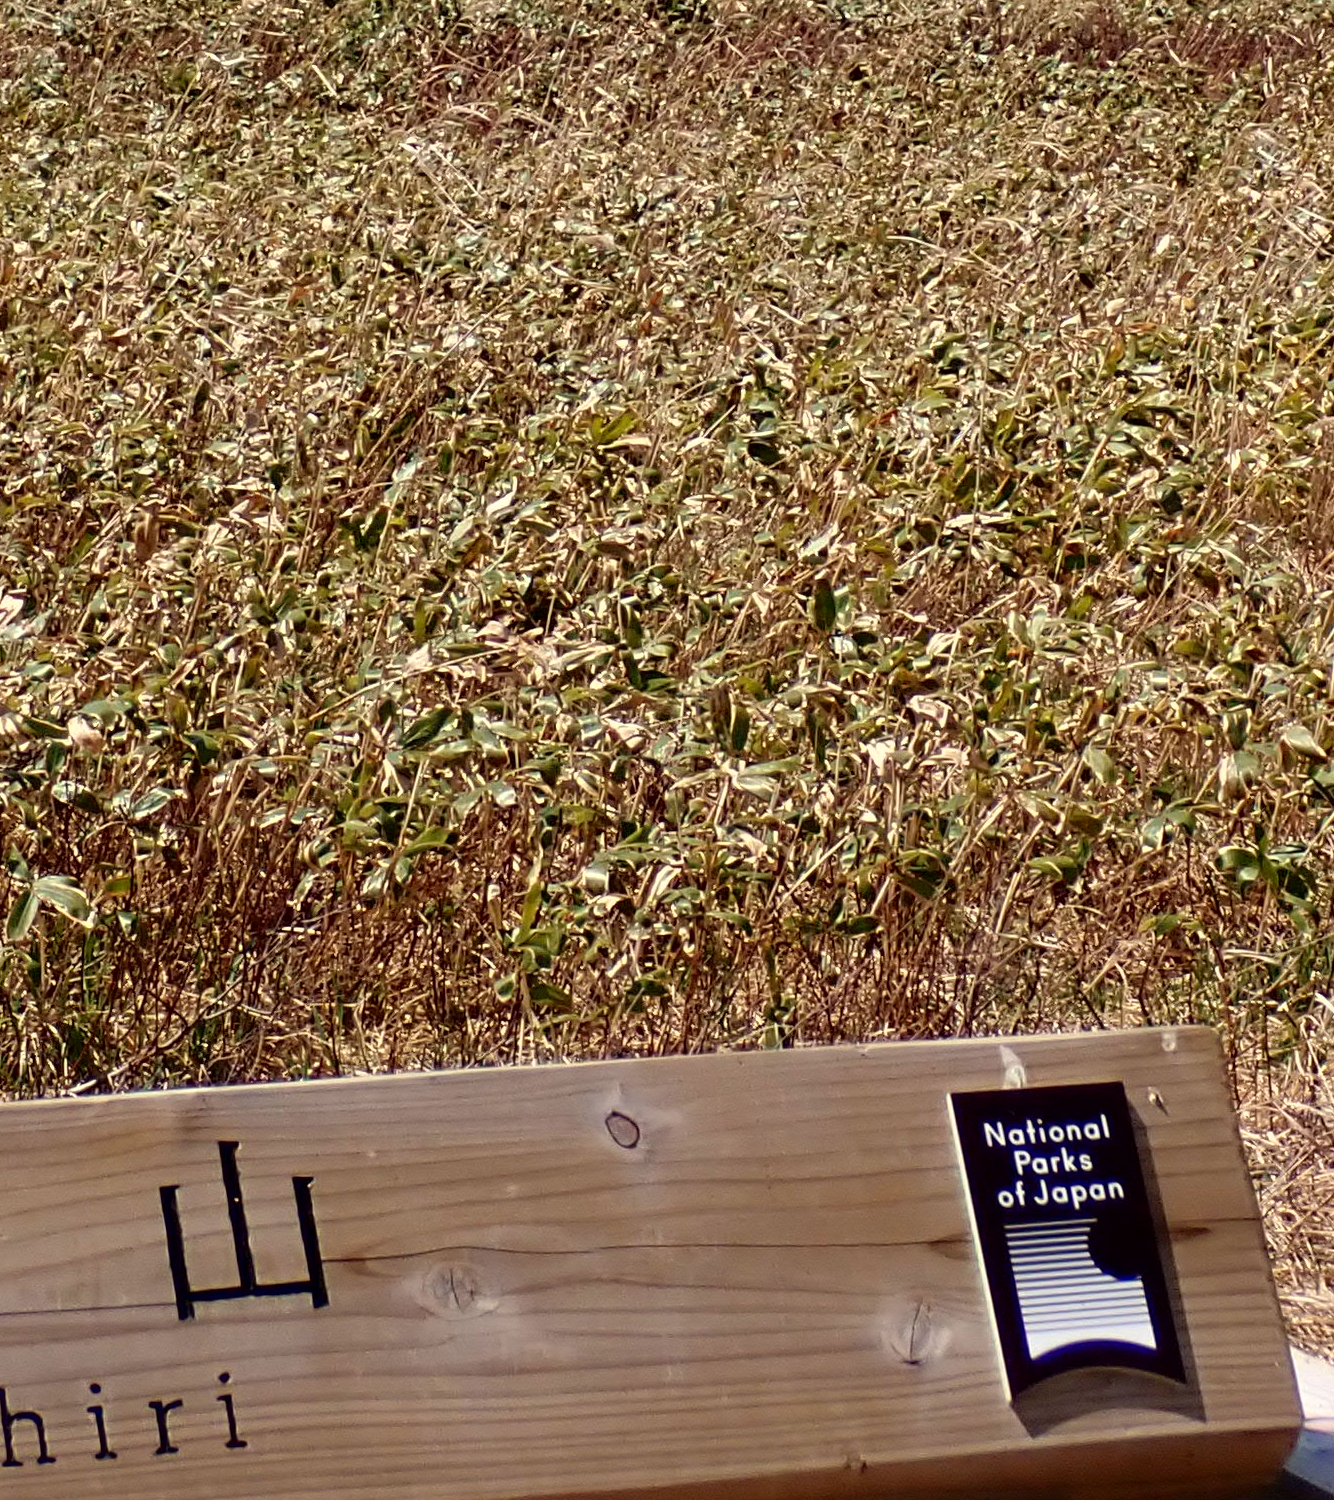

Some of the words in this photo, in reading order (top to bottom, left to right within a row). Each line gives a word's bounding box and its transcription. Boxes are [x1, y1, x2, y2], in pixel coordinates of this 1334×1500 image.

[983, 1113, 1110, 1147] National
[1014, 1146, 1094, 1176] Parks
[997, 1180, 1026, 1208] of
[1033, 1178, 1125, 1210] Japan
